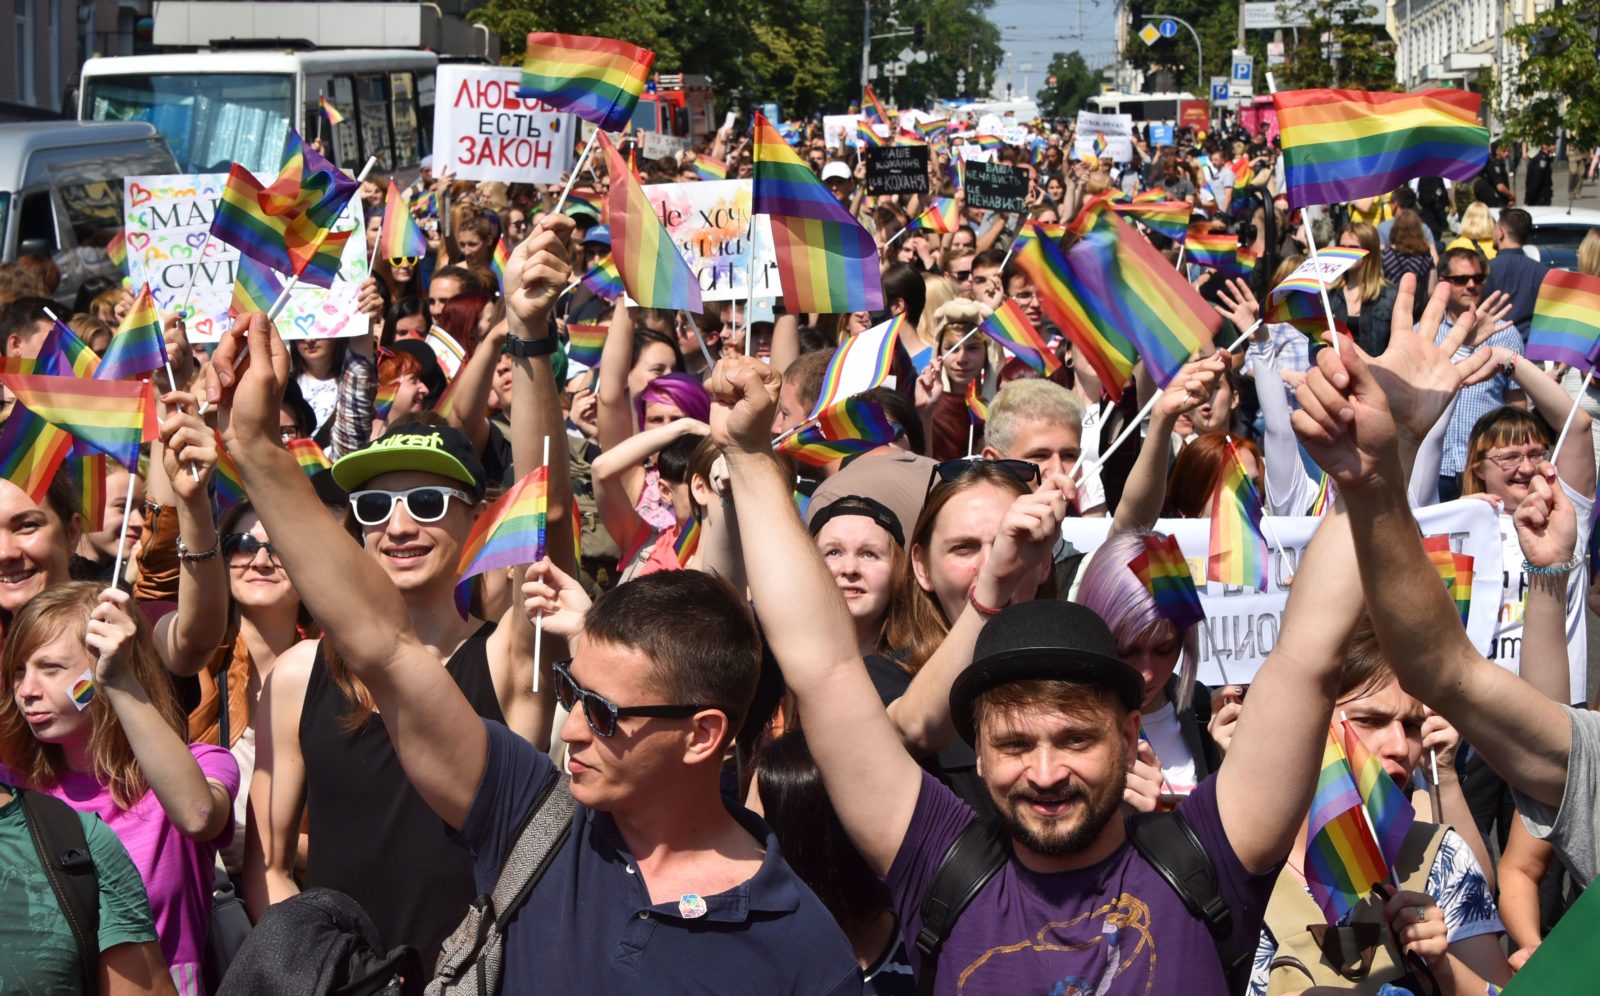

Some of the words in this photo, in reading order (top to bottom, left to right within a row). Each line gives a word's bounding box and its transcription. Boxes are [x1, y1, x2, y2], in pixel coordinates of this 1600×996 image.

[454, 79, 561, 113] ЛЮБ
[479, 112, 542, 138] ЕСТЬ
[457, 136, 552, 169] ЗАКОН
[882, 147, 911, 158] НАШЕ
[985, 163, 1014, 174] ВАША
[149, 197, 220, 231] MA
[162, 259, 239, 289] CIVI
